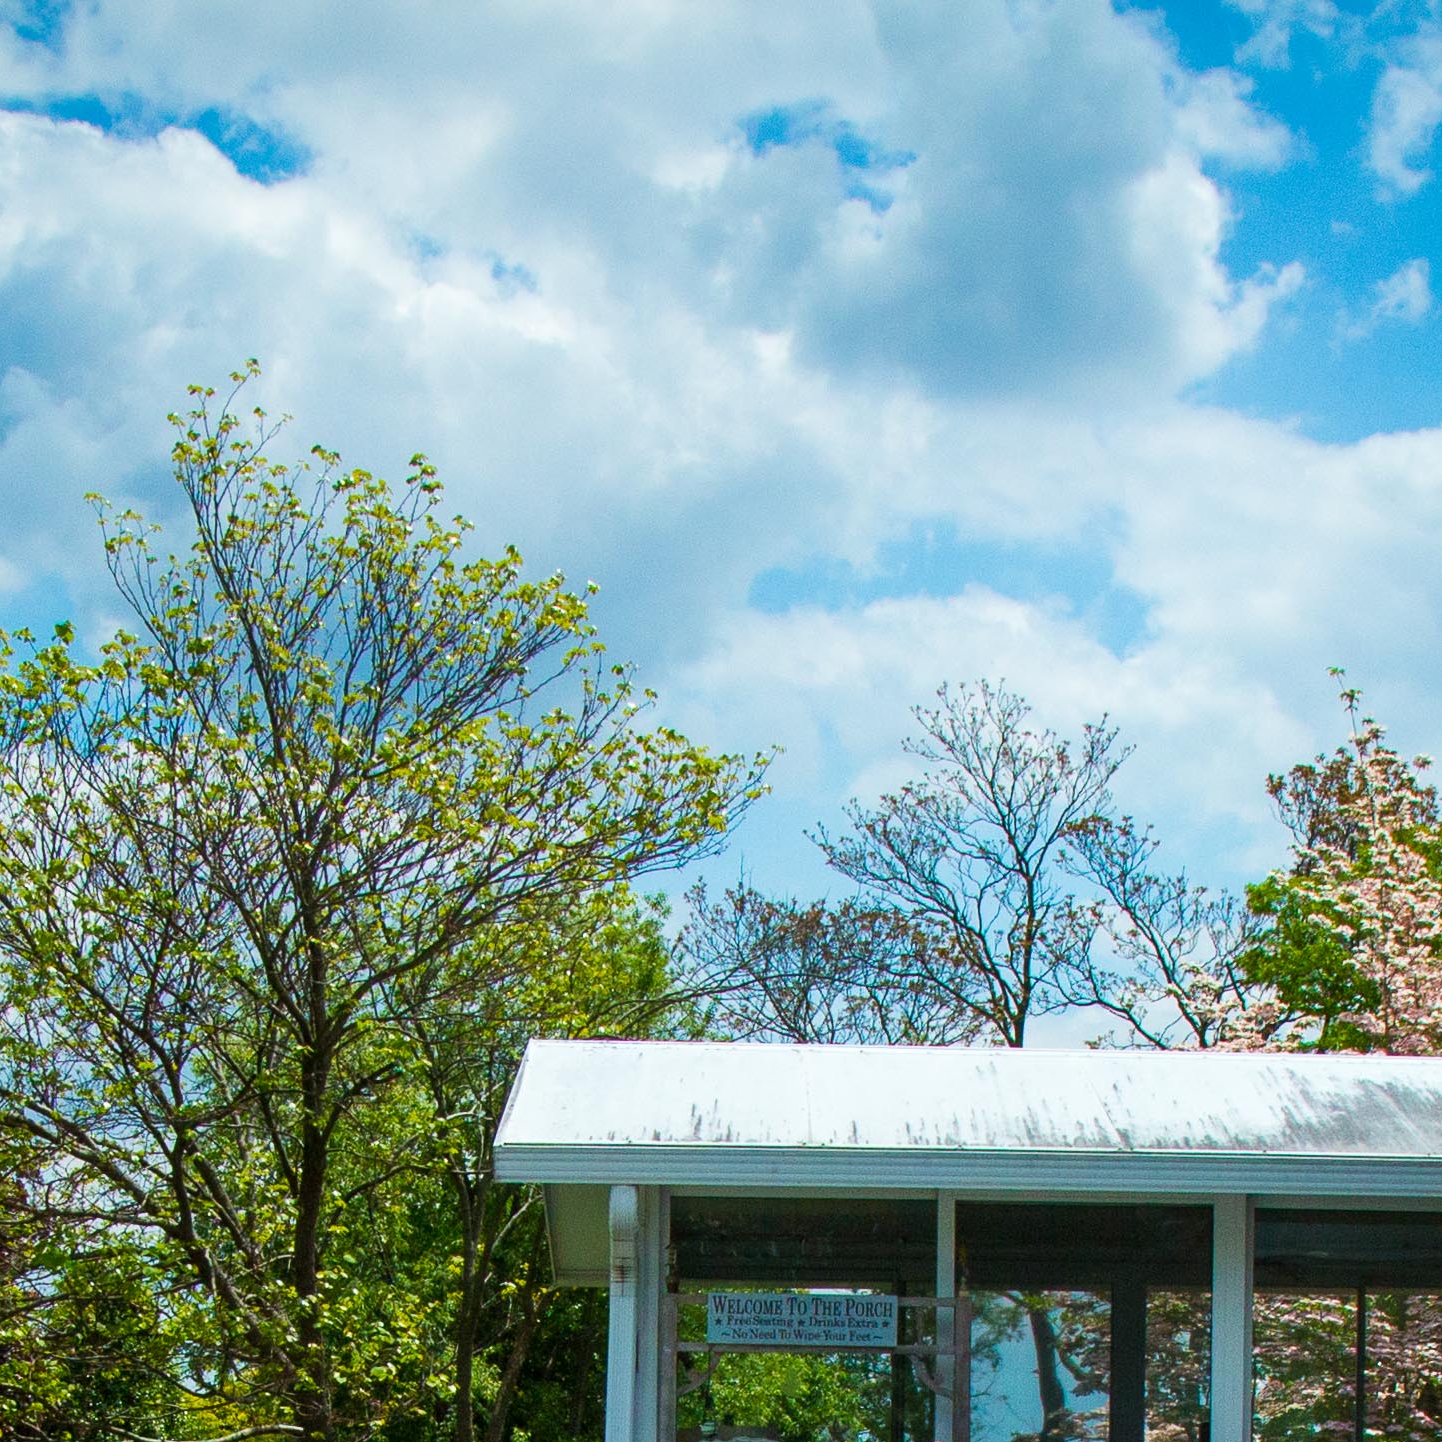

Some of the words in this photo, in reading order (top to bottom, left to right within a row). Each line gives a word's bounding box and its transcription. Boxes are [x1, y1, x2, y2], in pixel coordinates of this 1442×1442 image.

[811, 1297, 842, 1317] THE
[844, 1298, 893, 1318] PORCH
[727, 1315, 752, 1326] Free
[752, 1315, 794, 1328] Seating
[808, 1316, 846, 1328] Drinks
[847, 1318, 879, 1329] Extra
[749, 1328, 776, 1340] Need
[778, 1329, 791, 1340] To
[823, 1329, 846, 1341] Your
[849, 1330, 871, 1342] Feet
